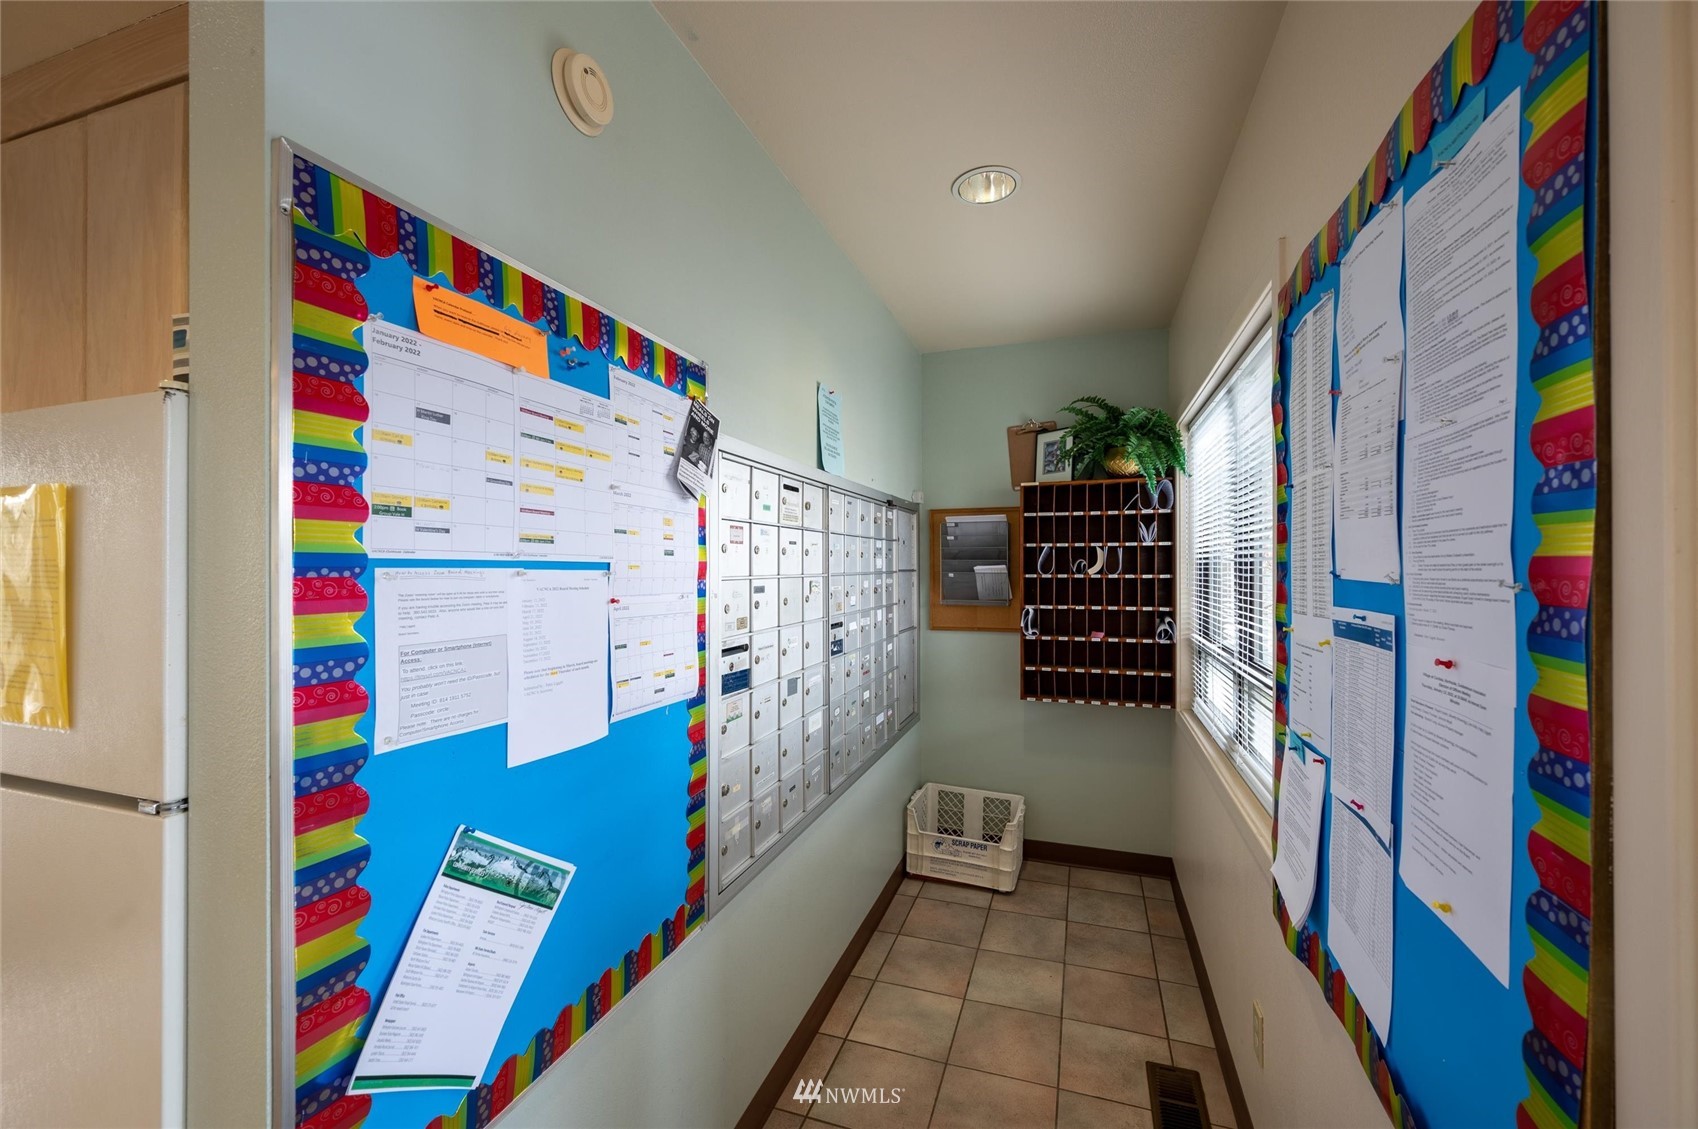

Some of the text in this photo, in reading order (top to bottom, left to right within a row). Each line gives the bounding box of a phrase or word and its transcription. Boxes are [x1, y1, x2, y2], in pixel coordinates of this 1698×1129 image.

[371, 327, 400, 341] January
[400, 336, 418, 346] 2022
[372, 337, 421, 357] February 2022
[614, 376, 627, 386] February
[692, 406, 710, 426] WHEELS
[693, 400, 715, 424] MEALS ON
[690, 412, 714, 436] AND MORE
[410, 648, 437, 656] Computer
[444, 644, 472, 652] Smartphone
[472, 641, 492, 649] (Internet)
[412, 684, 433, 692] probably
[410, 700, 430, 708] Meeting
[457, 711, 472, 719] charges
[399, 723, 449, 738] Computer/Smartphone
[951, 839, 970, 848] SCRAP
[970, 842, 988, 852] PAPER
